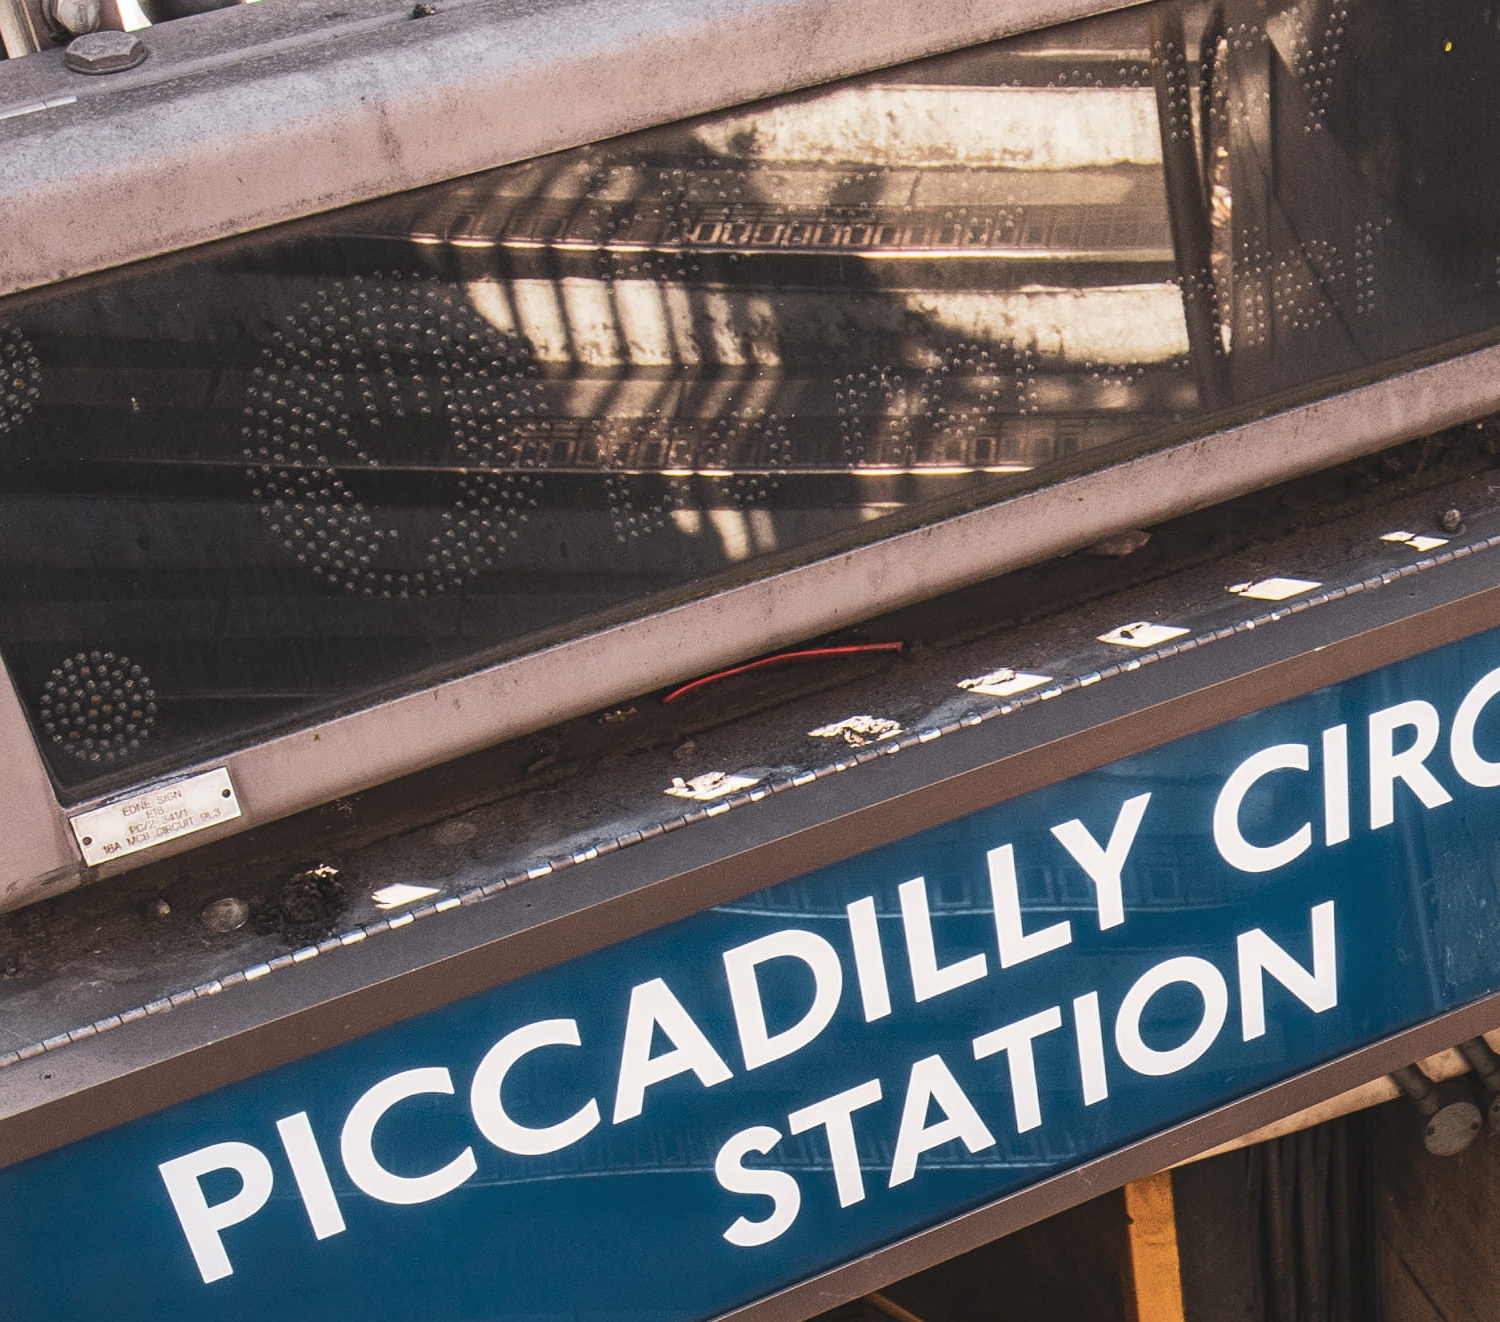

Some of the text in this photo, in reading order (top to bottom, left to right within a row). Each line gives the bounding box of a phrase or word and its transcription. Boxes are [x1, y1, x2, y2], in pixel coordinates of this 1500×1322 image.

[156, 790, 183, 806] SIGN
[156, 817, 194, 840] CIRCUIT
[158, 792, 1152, 1284] PICCADILLY
[714, 900, 1338, 1247] STATION
